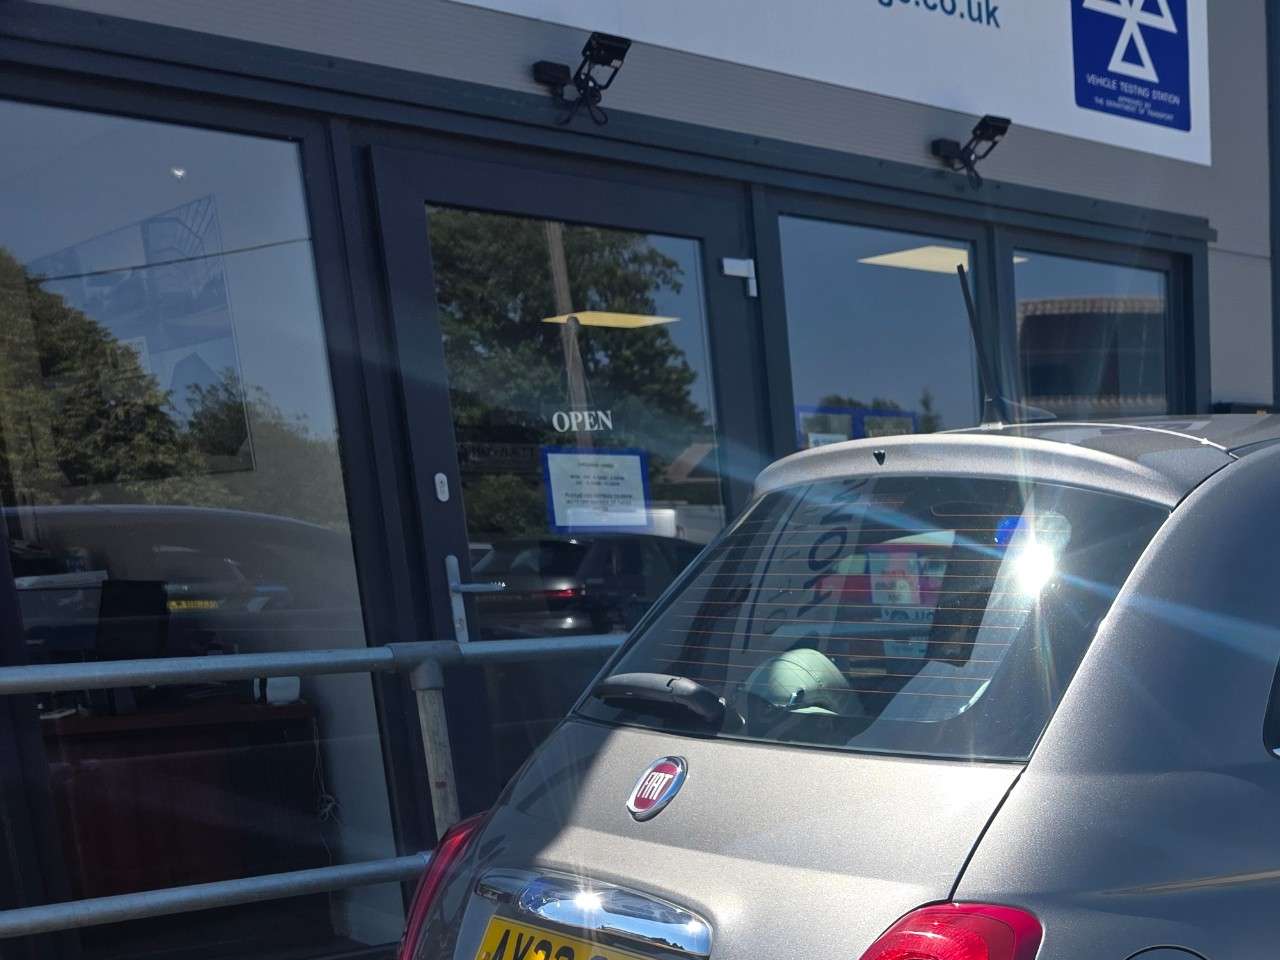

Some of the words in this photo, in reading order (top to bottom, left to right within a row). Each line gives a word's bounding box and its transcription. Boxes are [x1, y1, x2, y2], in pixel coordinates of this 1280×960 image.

[878, 0, 1000, 28] .co.uk
[552, 410, 613, 432] OPEN
[636, 771, 674, 801] FIAT
